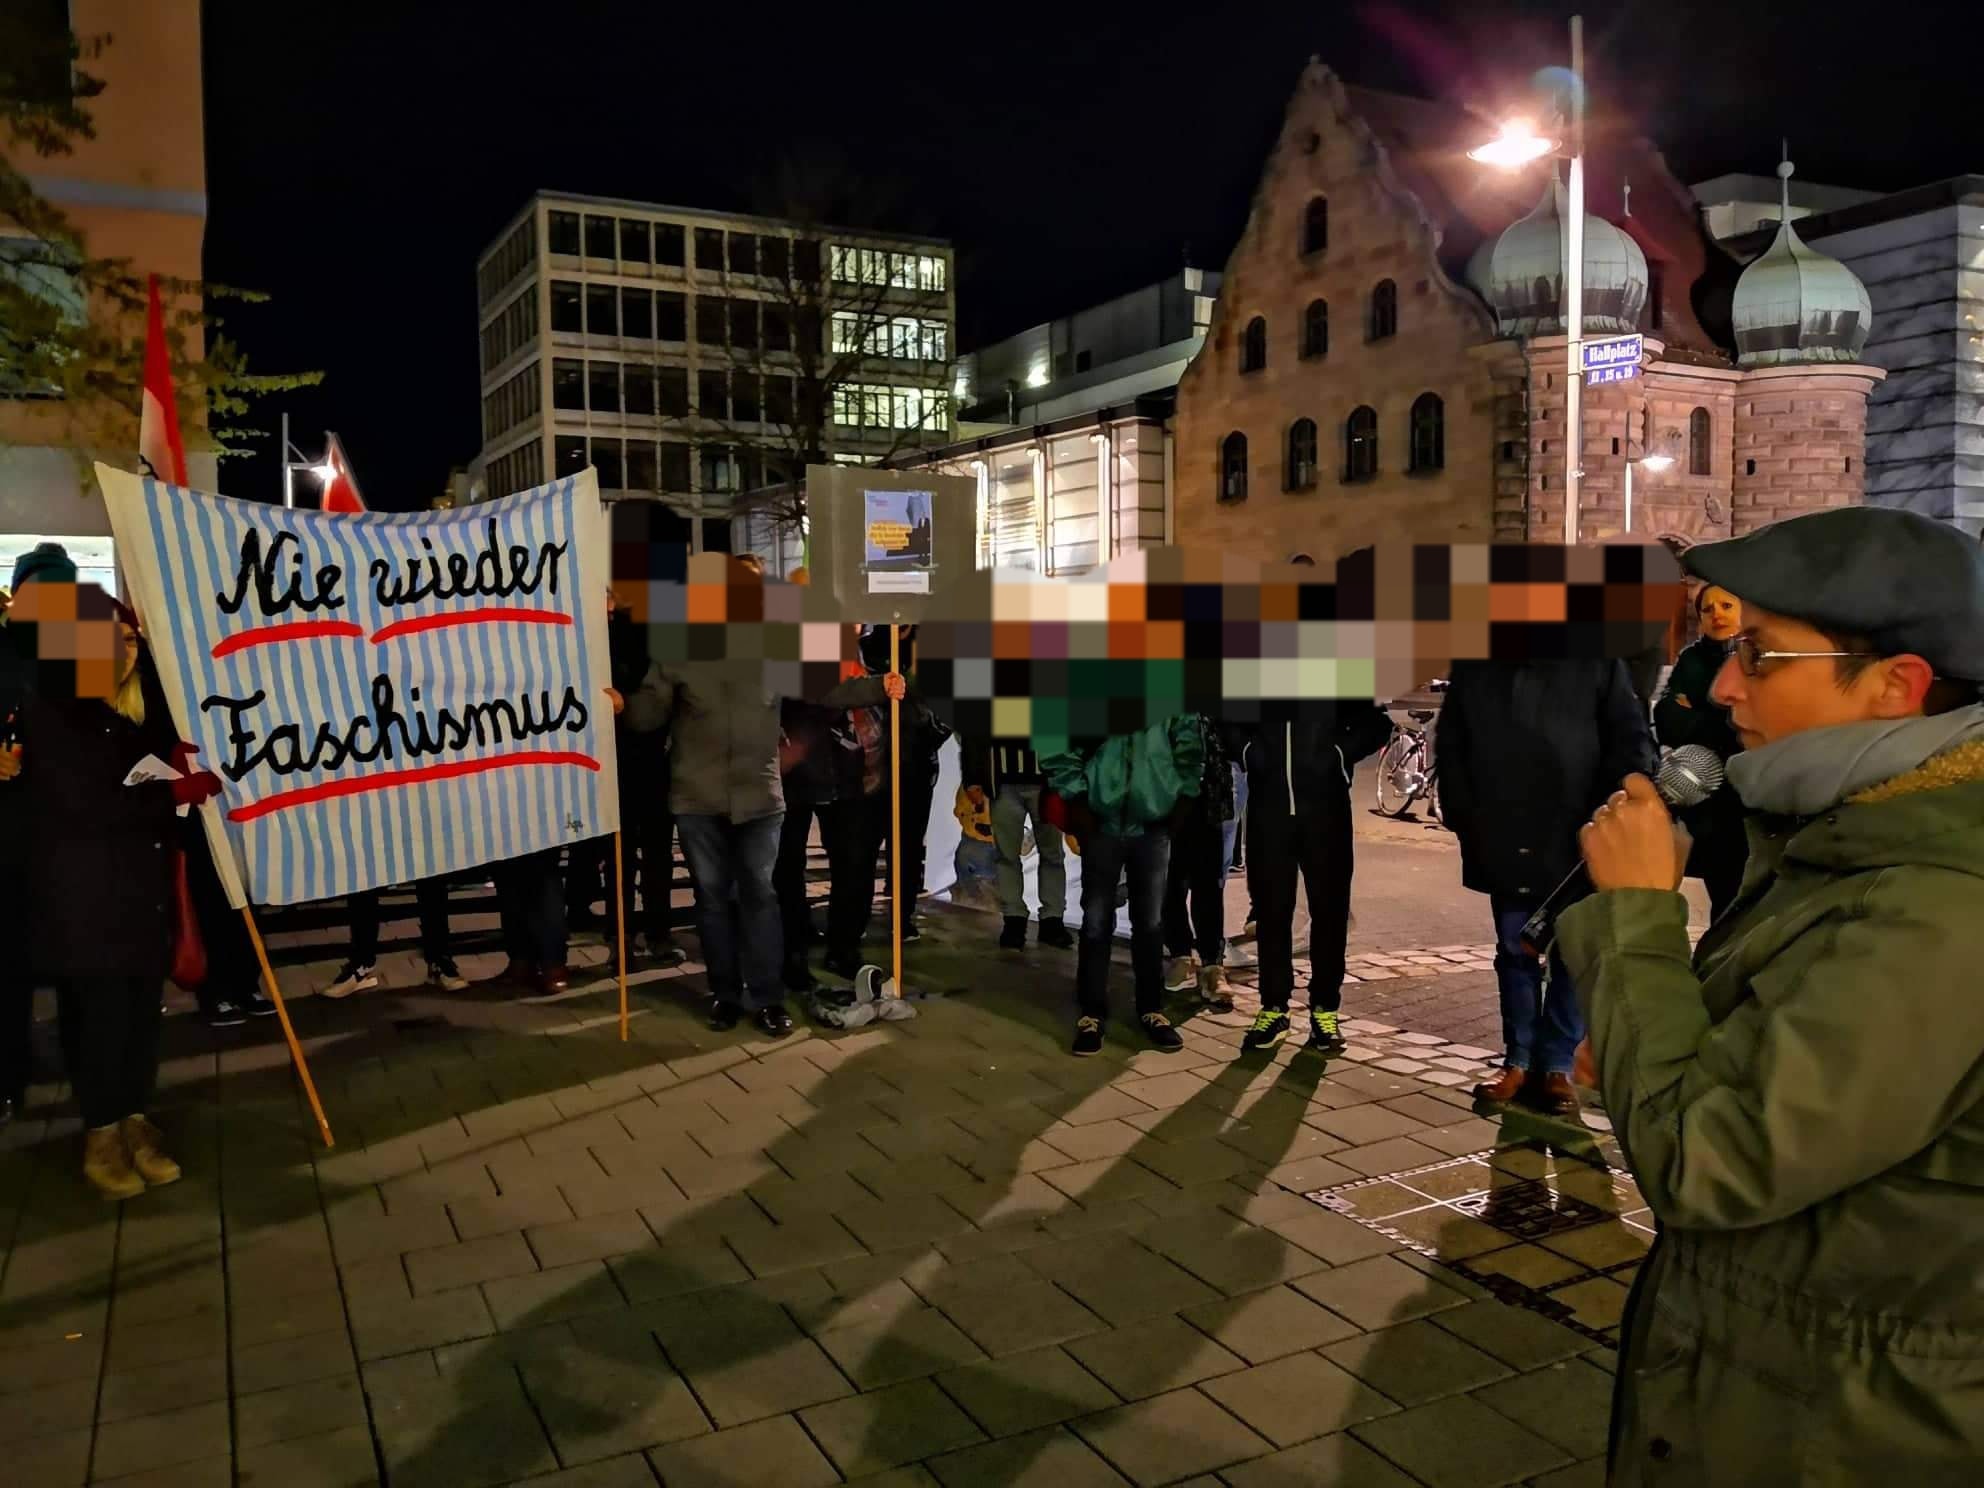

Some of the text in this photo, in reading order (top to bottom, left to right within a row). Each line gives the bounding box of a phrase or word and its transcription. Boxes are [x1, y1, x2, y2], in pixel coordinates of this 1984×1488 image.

[1589, 343, 1637, 363] Hallplatz
[216, 517, 569, 617] Nie wieder
[200, 673, 589, 783] Faschismus
